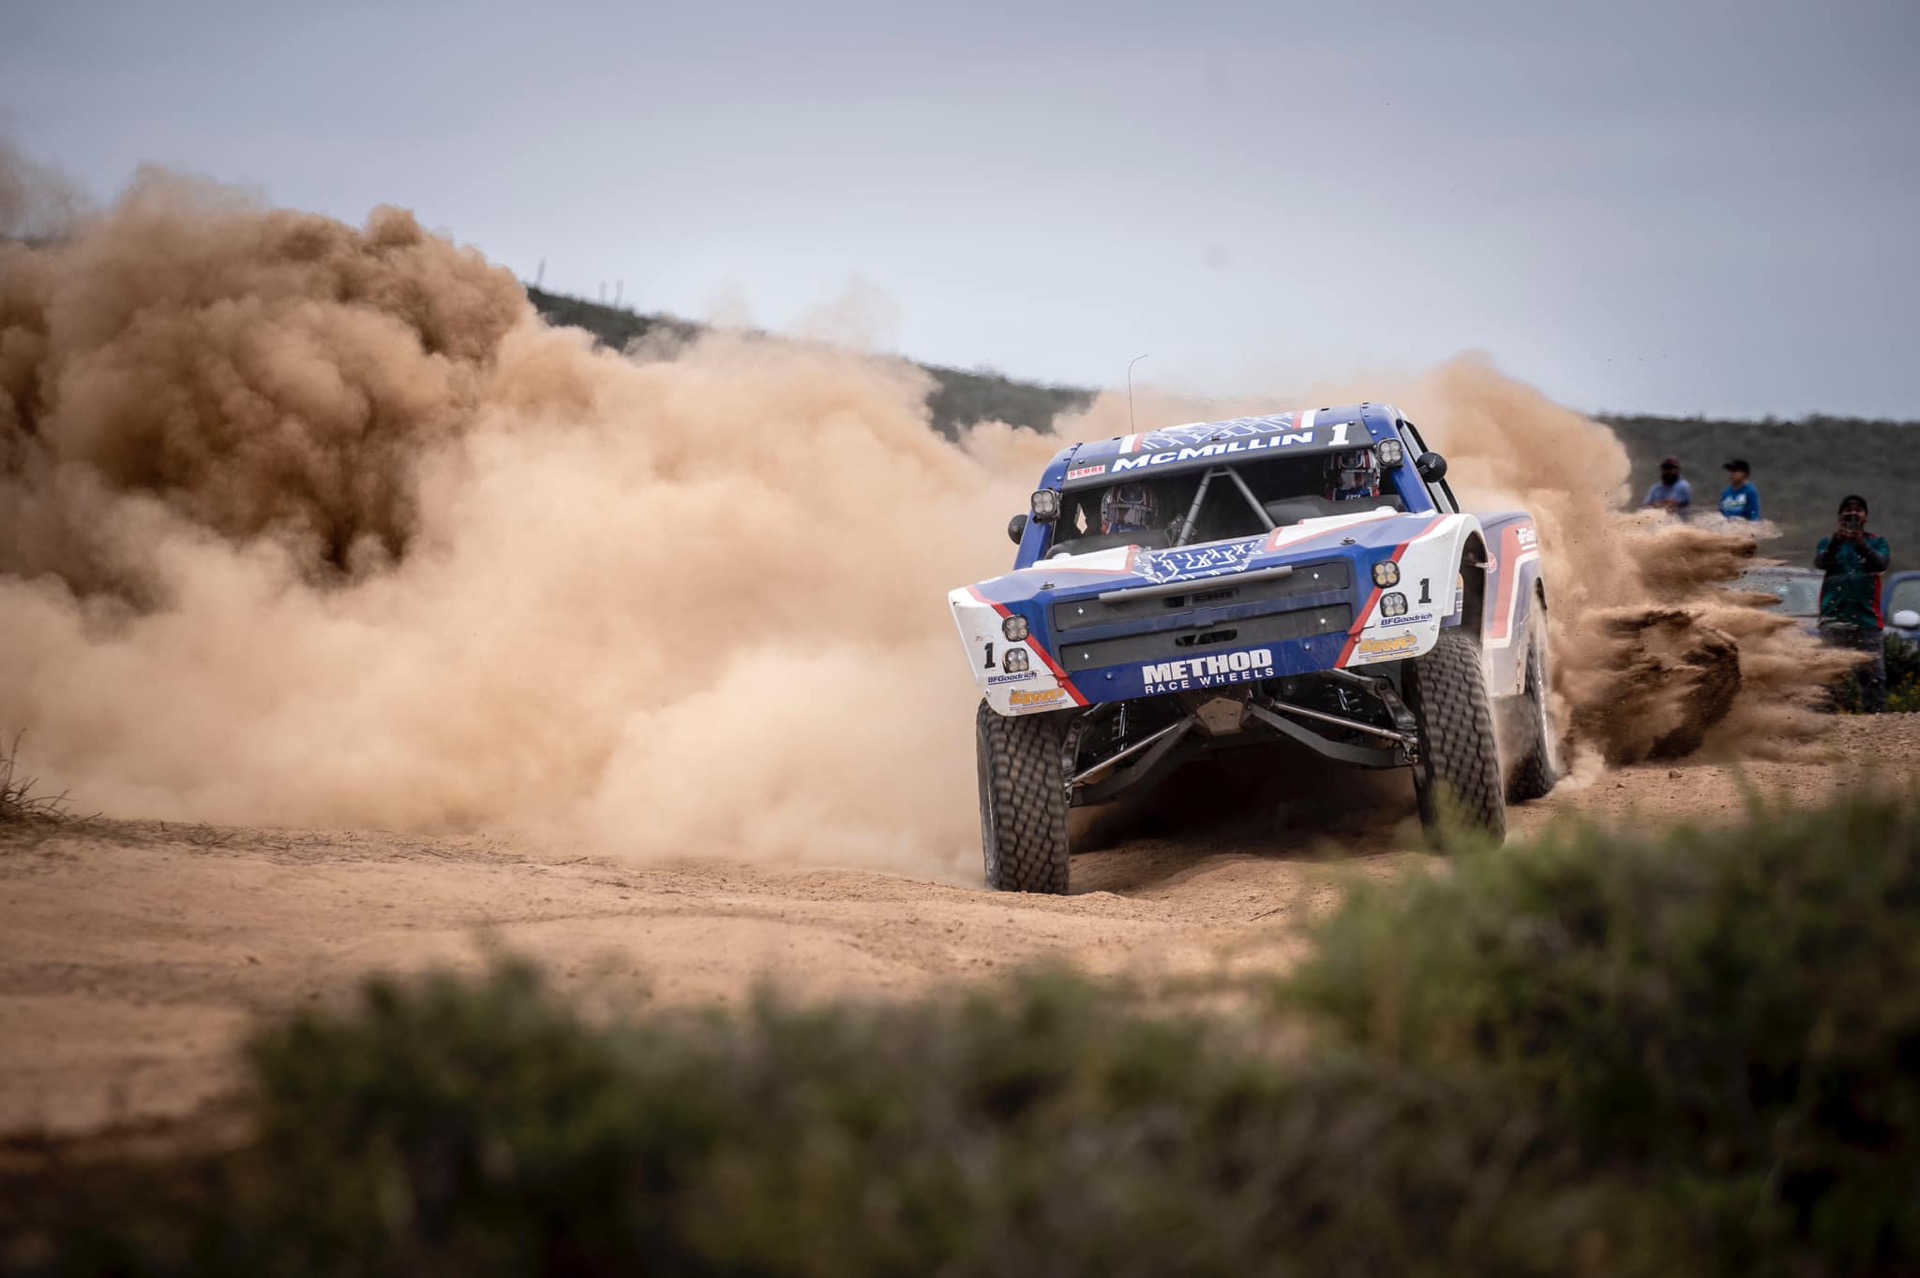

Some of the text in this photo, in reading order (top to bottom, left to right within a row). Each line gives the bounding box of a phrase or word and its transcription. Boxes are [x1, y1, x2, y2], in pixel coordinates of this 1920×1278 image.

[1328, 422, 1349, 446] 1
[1418, 577, 1432, 604] 1
[1380, 613, 1433, 627] BFGoodrich
[984, 642, 996, 669] 1
[1141, 648, 1273, 685] METHOD
[987, 672, 1037, 684] BFGoodrich
[1145, 667, 1275, 695] RACE WHEELS
